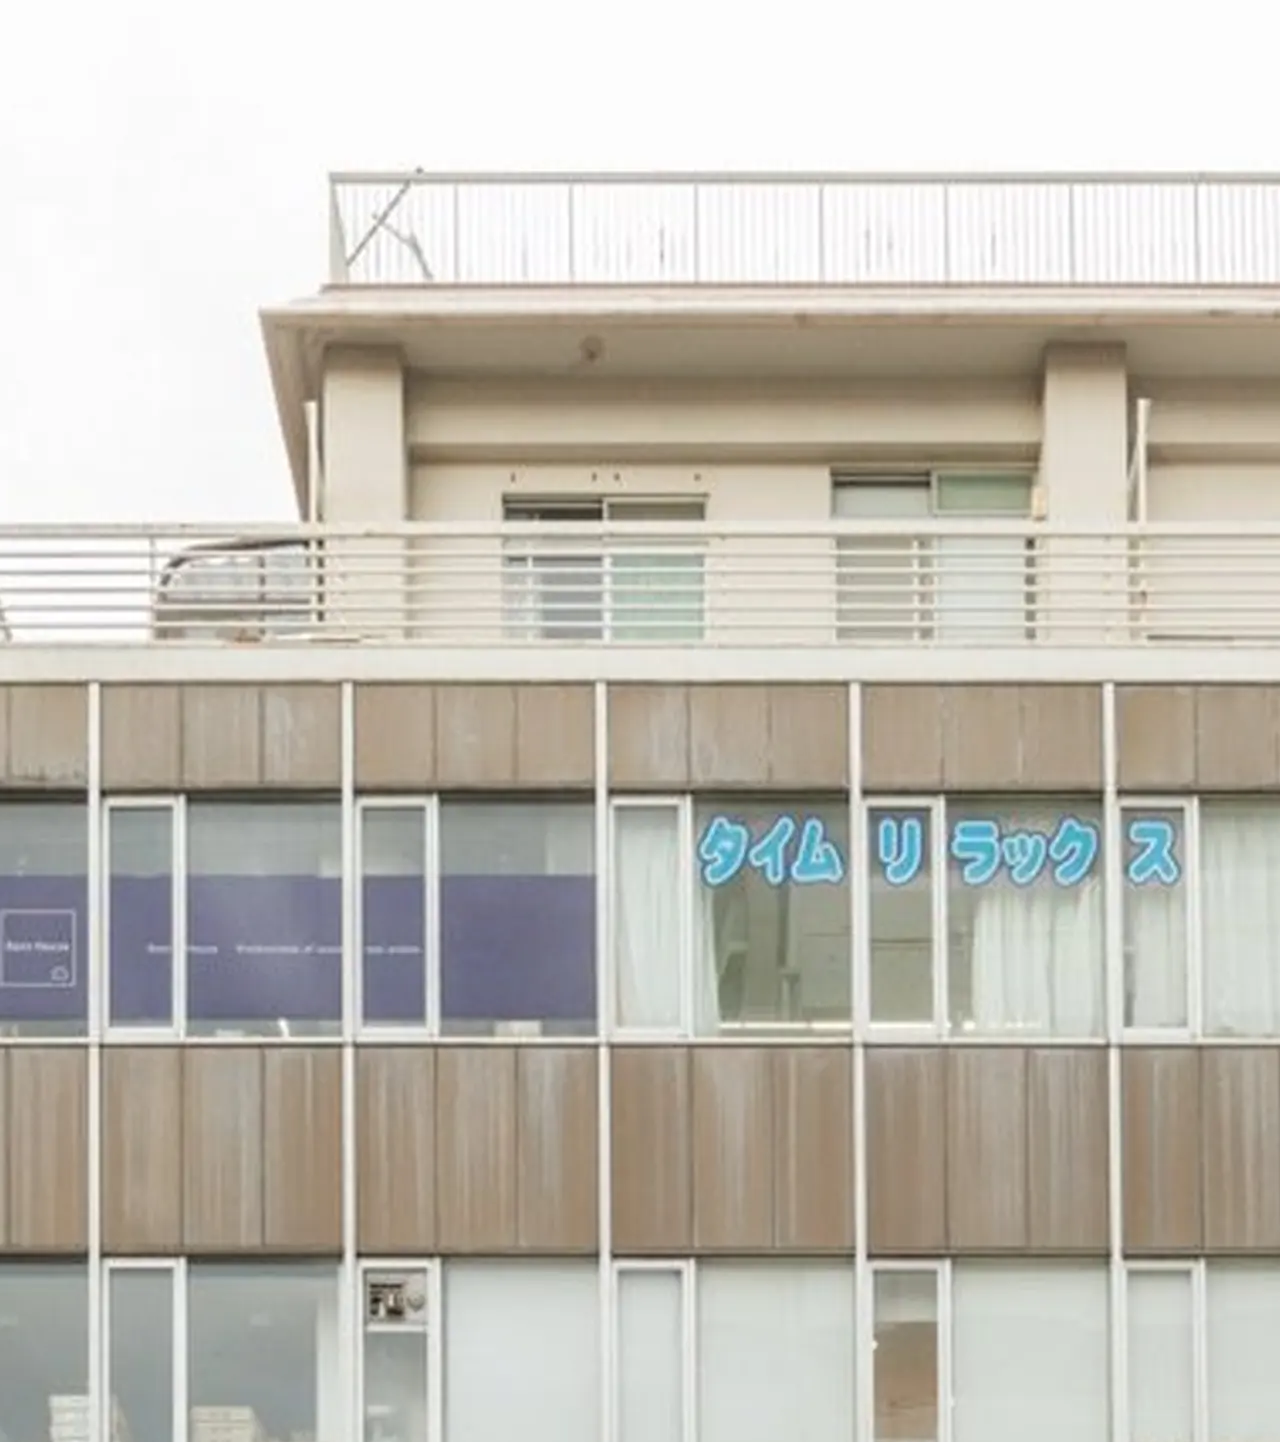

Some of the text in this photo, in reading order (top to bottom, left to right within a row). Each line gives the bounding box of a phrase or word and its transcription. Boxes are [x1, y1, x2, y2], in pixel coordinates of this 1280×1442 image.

[699, 815, 1180, 886] タイムリラックス
